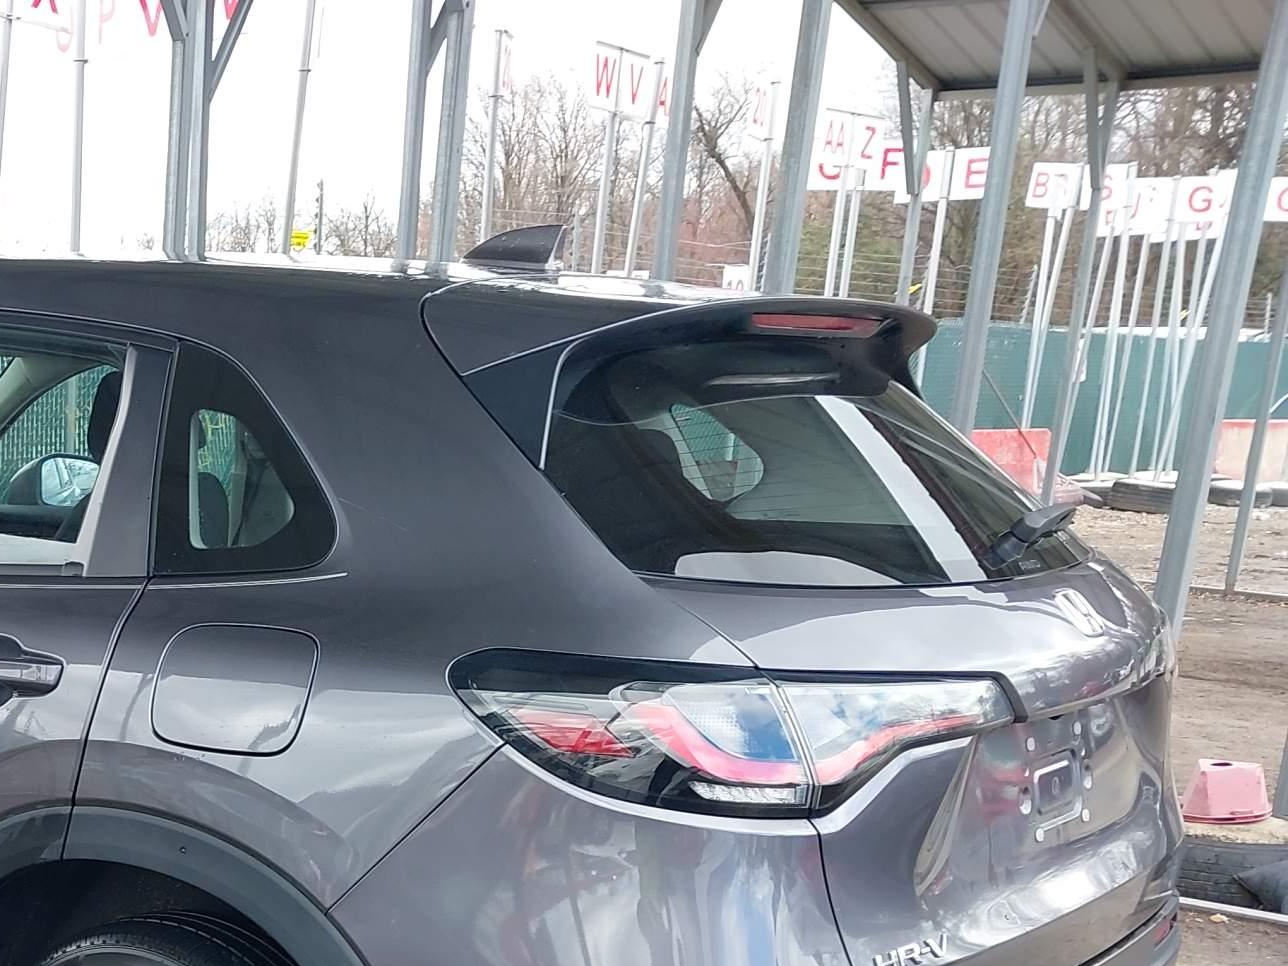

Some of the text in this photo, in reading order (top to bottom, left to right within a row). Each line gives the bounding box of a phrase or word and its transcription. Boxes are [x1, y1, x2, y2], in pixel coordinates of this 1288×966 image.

[597, 53, 645, 105] W V
[860, 125, 877, 160] Z
[963, 157, 990, 189] E
[1031, 172, 1050, 198] B
[1187, 185, 1214, 213] G
